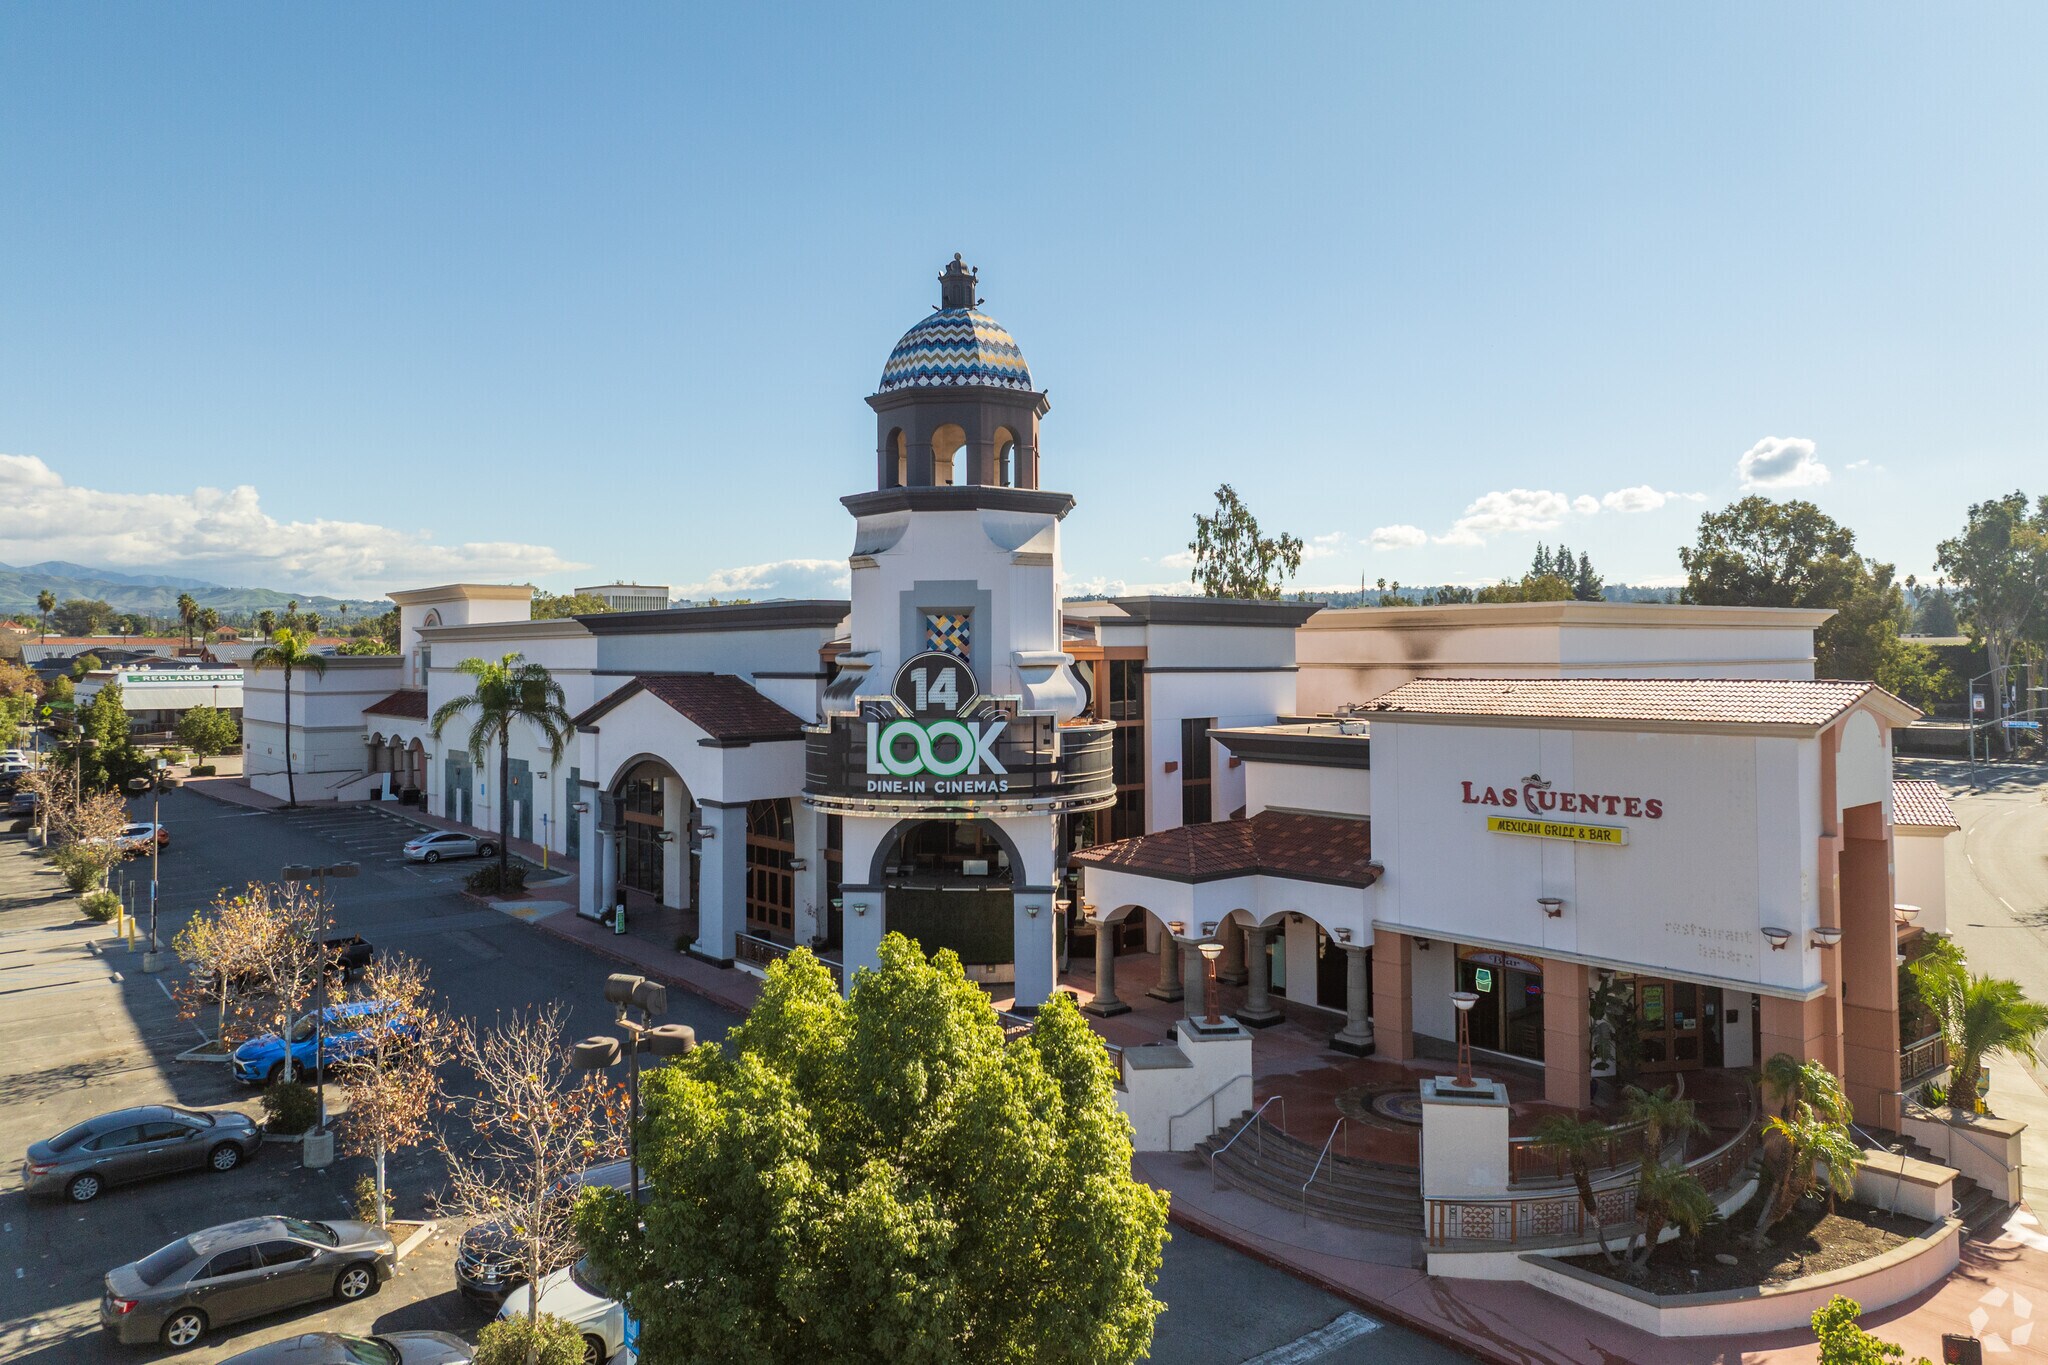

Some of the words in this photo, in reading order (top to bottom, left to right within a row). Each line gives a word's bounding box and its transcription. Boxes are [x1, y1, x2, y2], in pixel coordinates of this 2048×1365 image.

[911, 667, 959, 711] 14
[866, 720, 1009, 777] LOOK
[867, 780, 926, 793] DINE-IN
[934, 780, 1009, 793] CINEMAS
[1498, 821, 1541, 834] MEXICAN
[1545, 825, 1575, 838] GRILL
[1578, 828, 1585, 839] &
[1588, 829, 1611, 841] BAR
